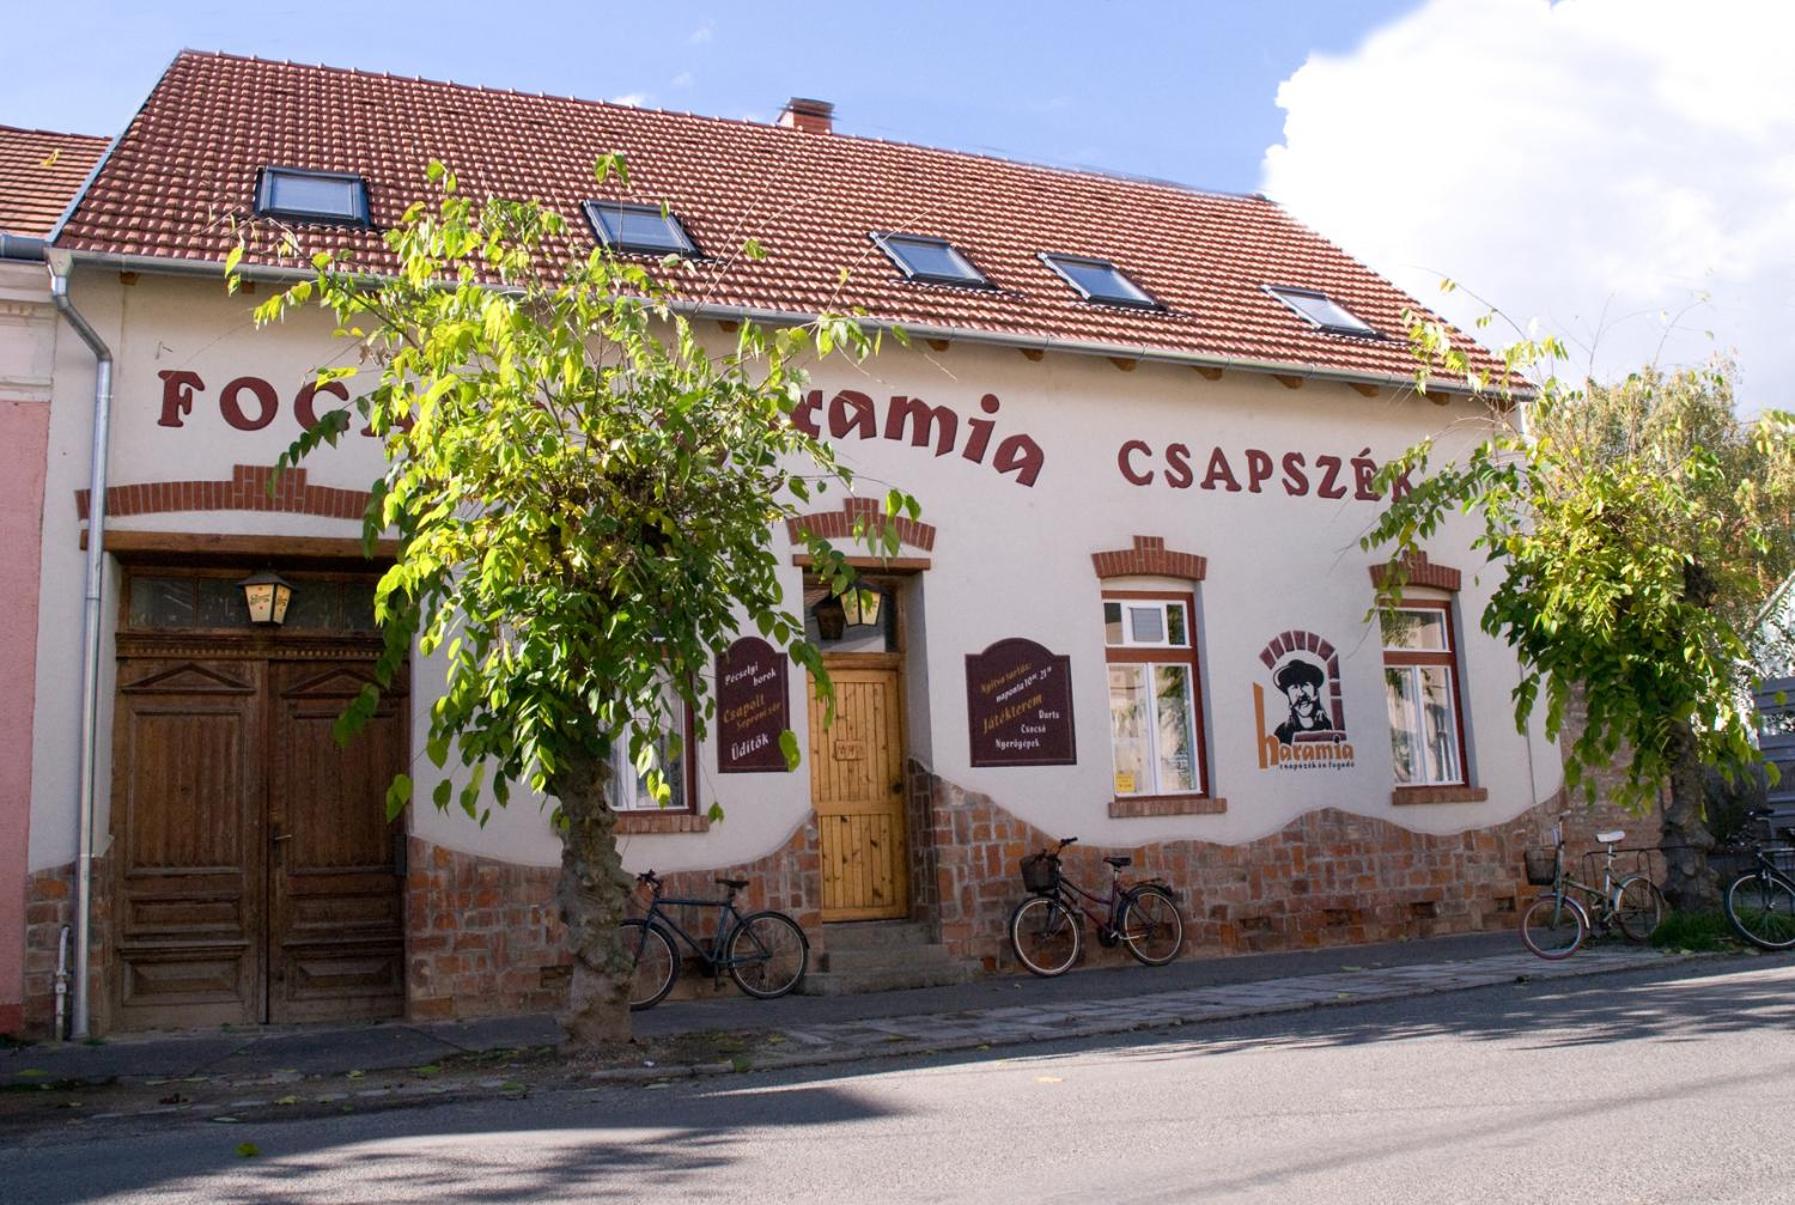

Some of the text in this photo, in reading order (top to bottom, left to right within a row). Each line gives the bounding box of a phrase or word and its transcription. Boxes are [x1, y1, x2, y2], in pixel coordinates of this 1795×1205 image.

[1118, 440, 1416, 502] CSAPSZÉK
[753, 667, 776, 686] borok
[1039, 709, 1060, 719] Darts
[1253, 682, 1354, 770] haramia
